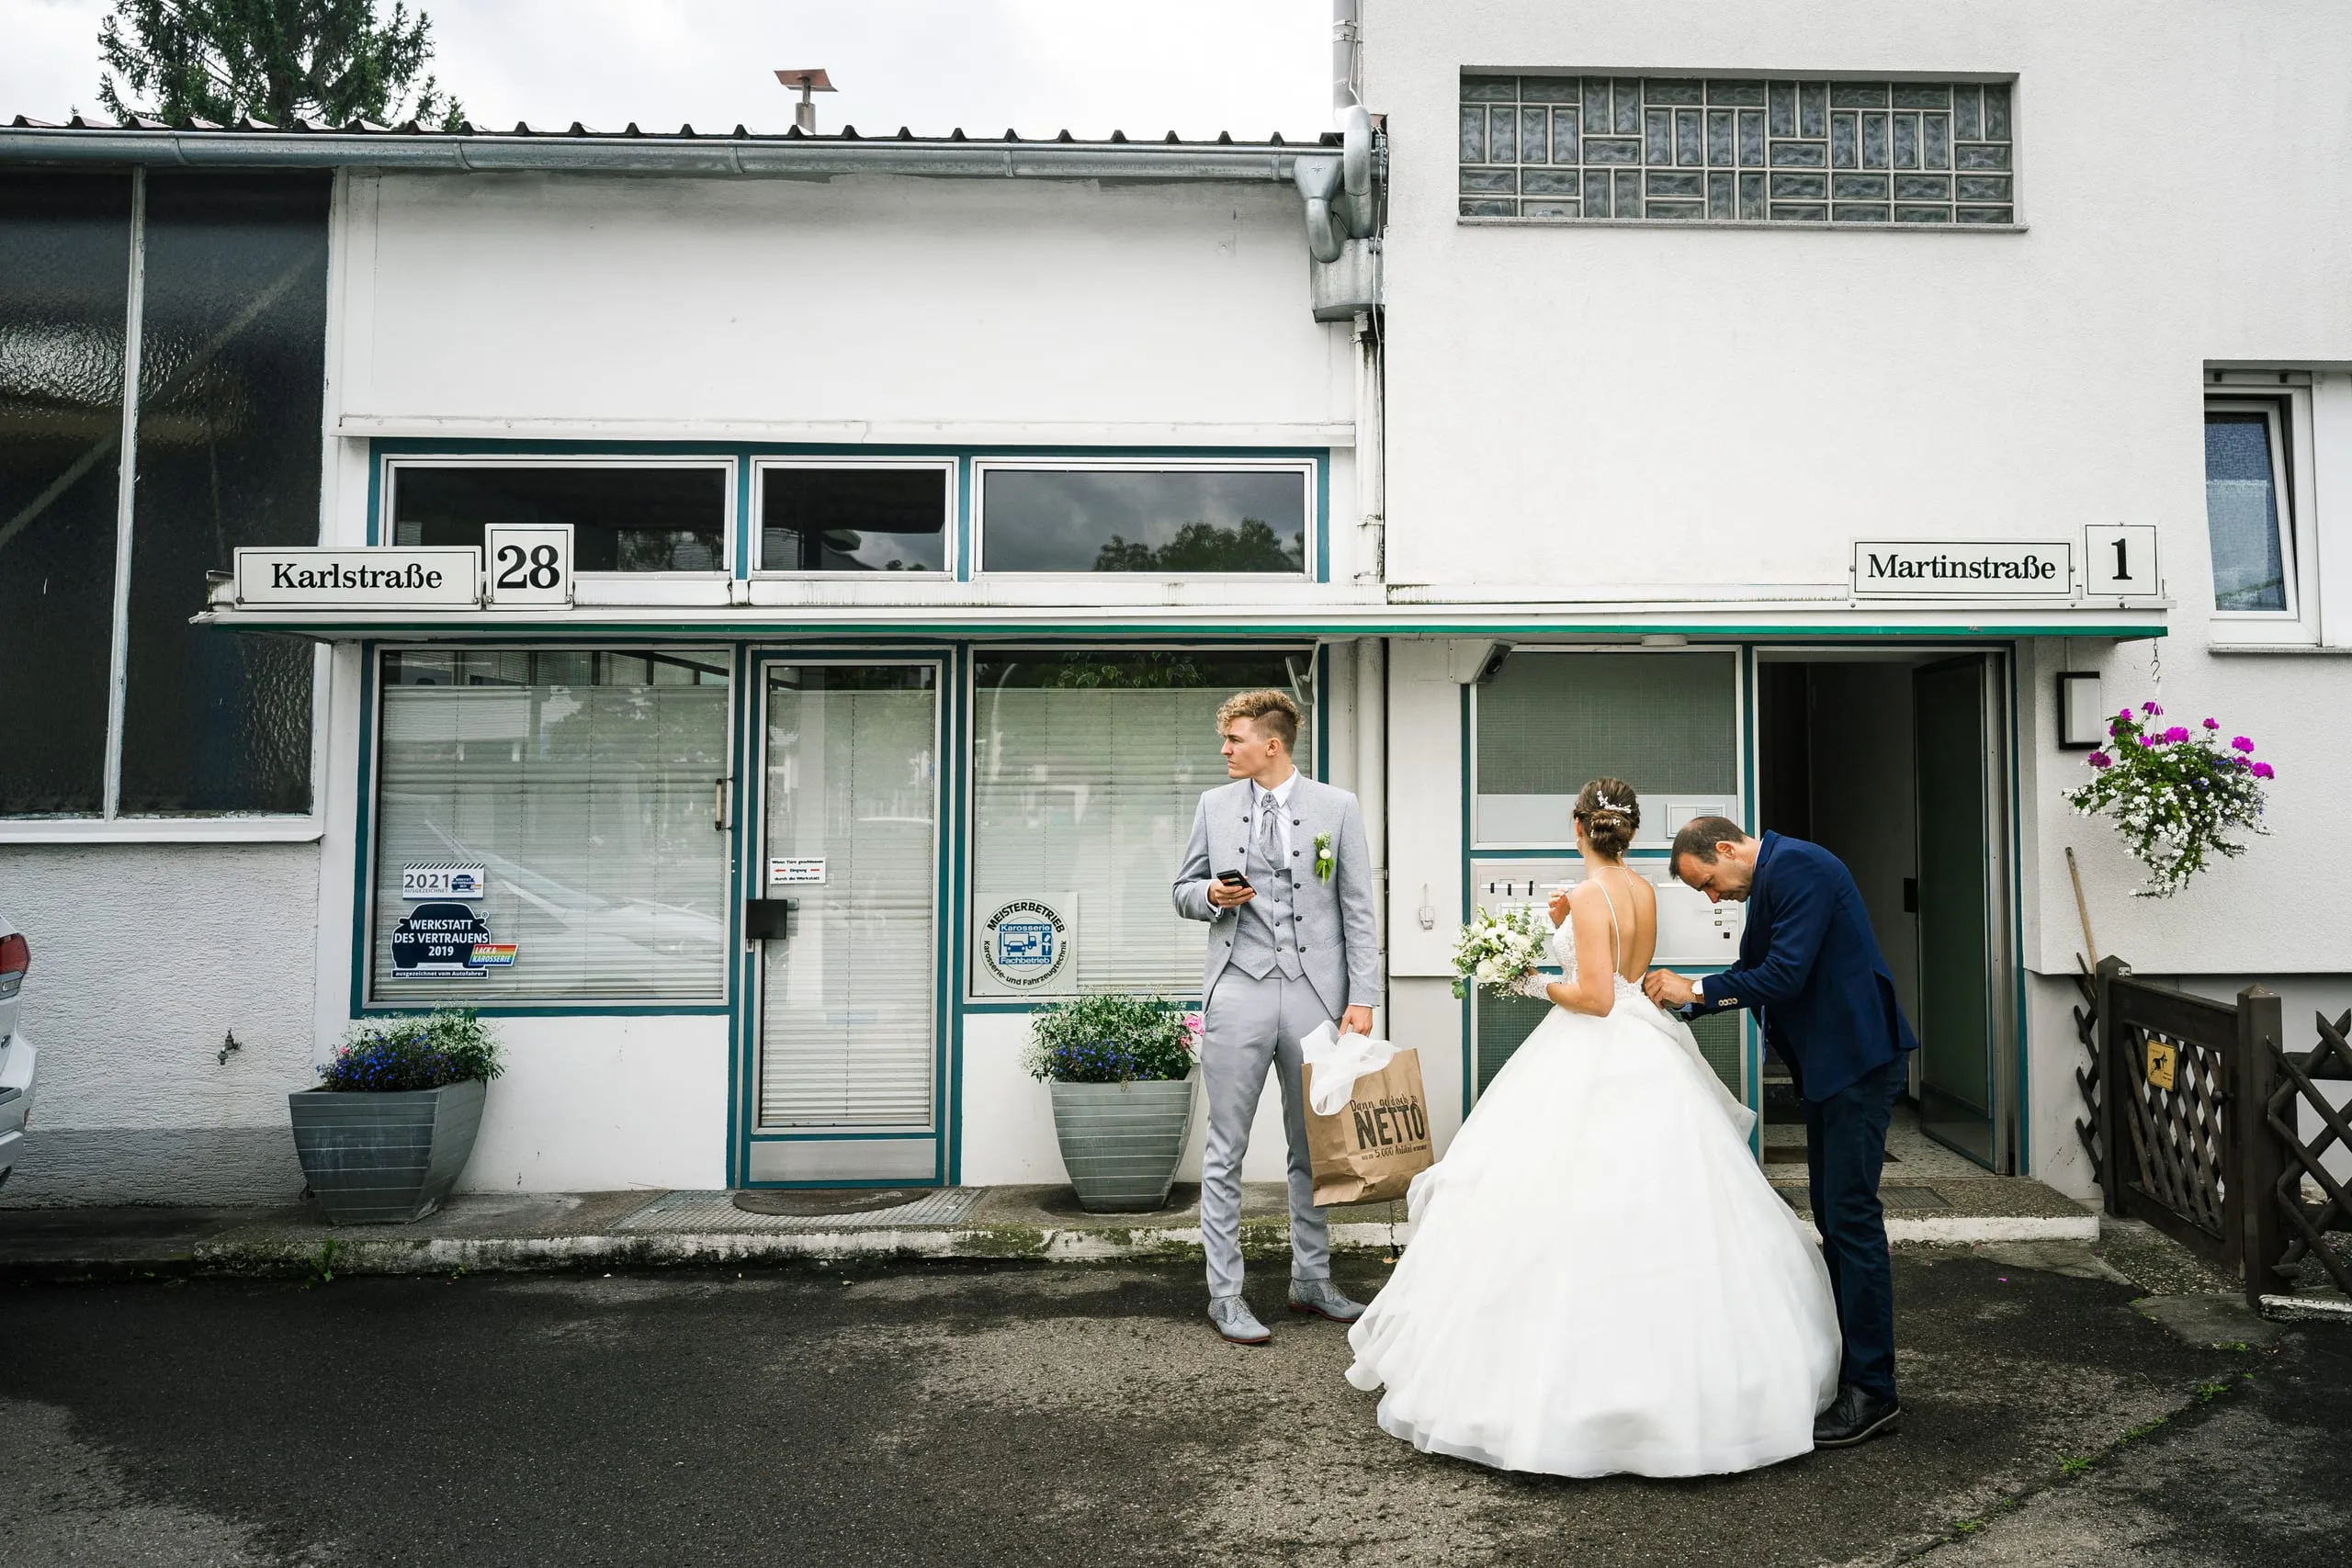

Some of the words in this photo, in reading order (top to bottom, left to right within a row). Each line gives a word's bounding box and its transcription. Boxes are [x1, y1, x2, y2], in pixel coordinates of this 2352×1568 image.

[496, 544, 560, 590] 28
[1867, 553, 2056, 580] Martinstraße
[2111, 538, 2132, 581] 1
[270, 562, 444, 590] Karlstraße
[404, 874, 449, 888] 2021
[410, 919, 473, 931] WERKSTATT
[987, 902, 1066, 933] MEISTERBETRIEB
[394, 932, 414, 943] DES
[417, 932, 489, 943] VERTRAUENS
[428, 945, 454, 956] 2019
[984, 940, 1006, 979] Karosserie-
[1005, 977, 1022, 986] und
[1023, 940, 1067, 986] Fahrzeugtechnik
[1350, 1099, 1375, 1112] Dann
[1353, 1103, 1425, 1150] NETTO
